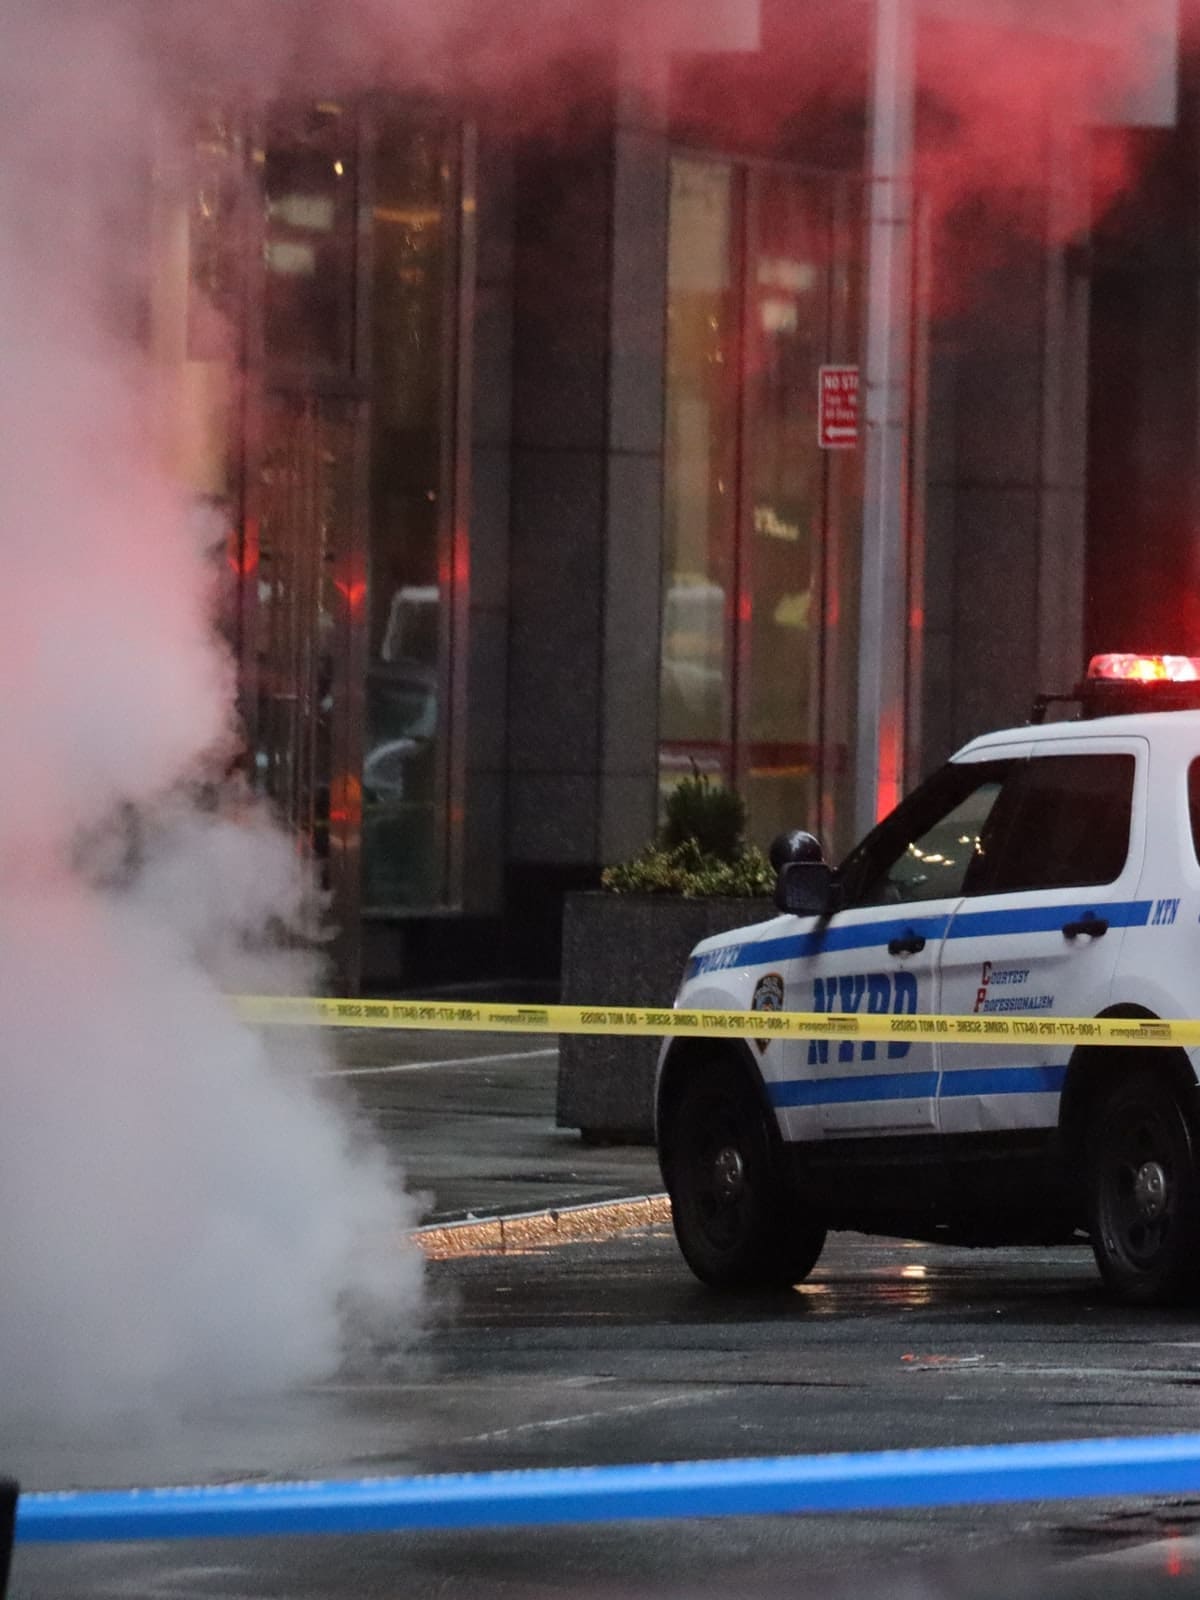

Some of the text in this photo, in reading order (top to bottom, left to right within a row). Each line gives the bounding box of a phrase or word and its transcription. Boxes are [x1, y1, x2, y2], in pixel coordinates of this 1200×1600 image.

[825, 376, 839, 389] NO
[973, 988, 1054, 1013] PROFESSIONALISM
[807, 972, 918, 1065] NYPD
